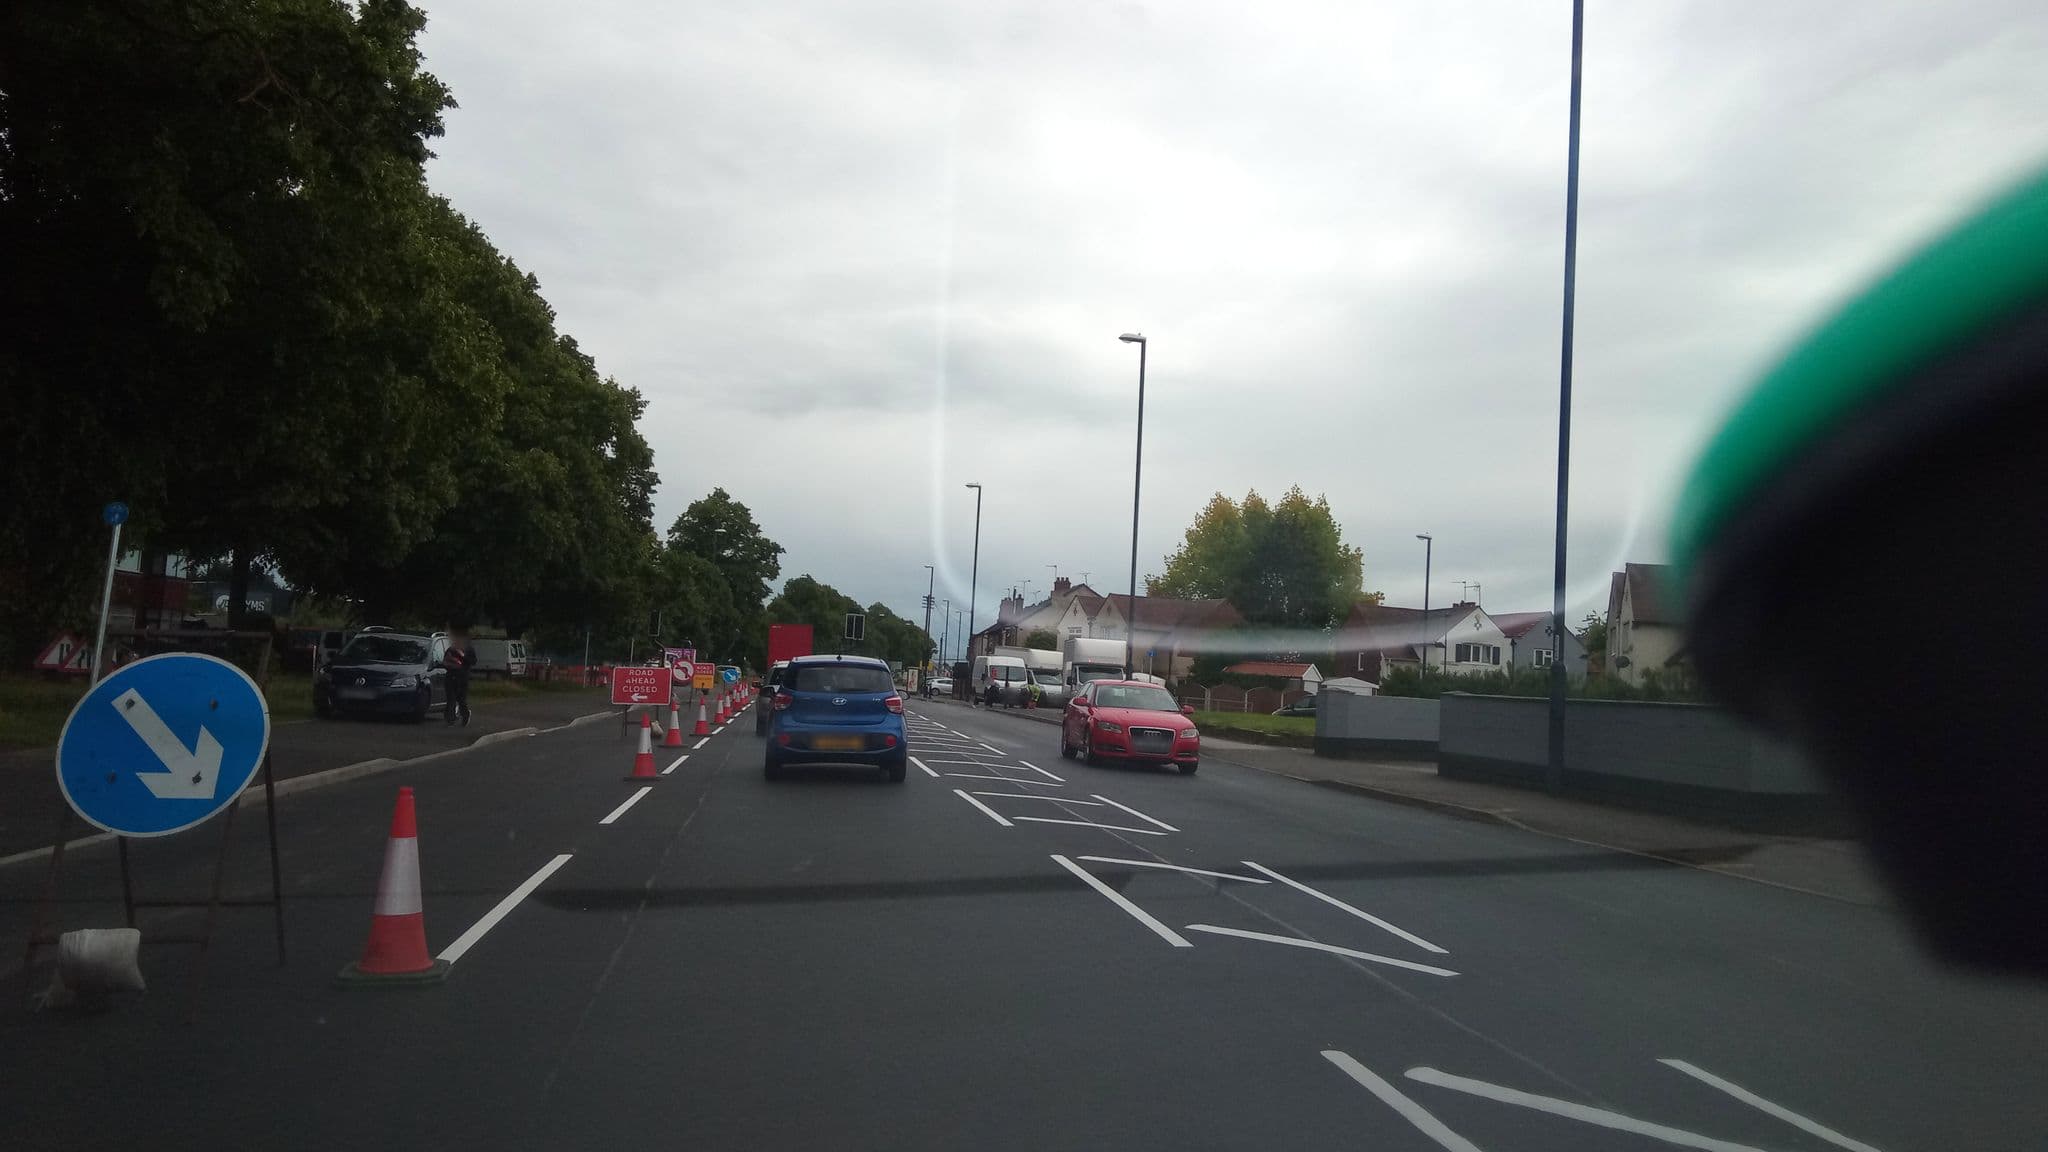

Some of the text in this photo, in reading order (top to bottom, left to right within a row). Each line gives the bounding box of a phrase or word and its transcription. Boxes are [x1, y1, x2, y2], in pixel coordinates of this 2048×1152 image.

[245, 600, 264, 611] YMS
[625, 677, 656, 685] AHEAD
[622, 685, 658, 693] CLOSED
